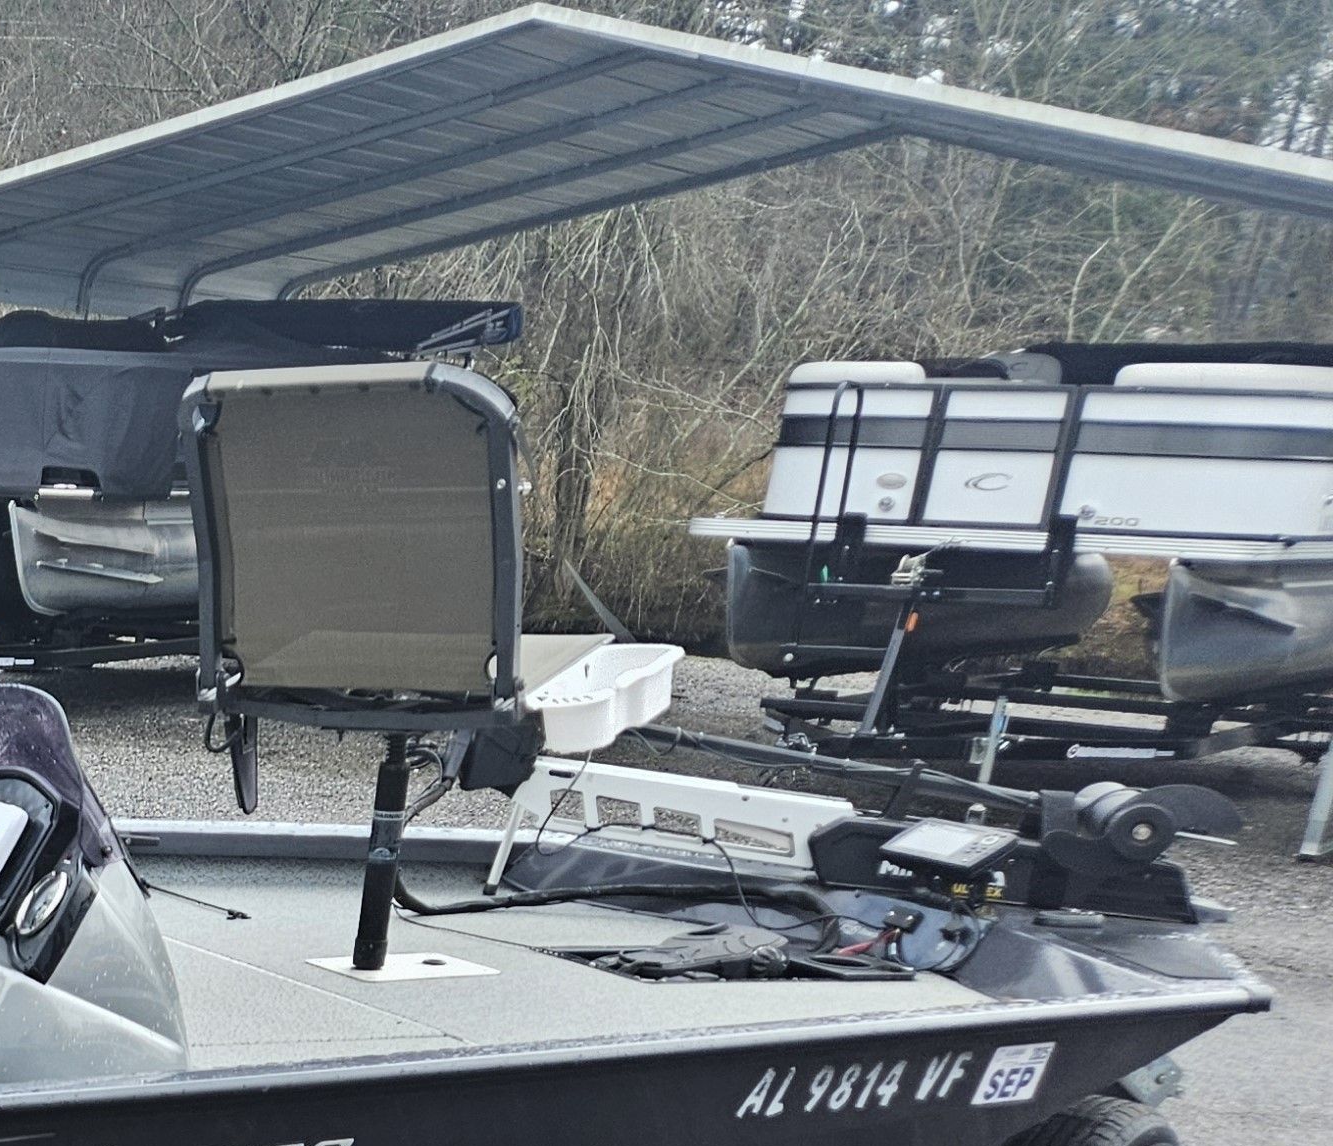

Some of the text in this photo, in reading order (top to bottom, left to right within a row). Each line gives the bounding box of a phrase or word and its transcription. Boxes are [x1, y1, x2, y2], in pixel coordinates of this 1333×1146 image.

[1093, 516, 1141, 527] 200
[735, 1051, 973, 1119] AL 9814 VF
[984, 1066, 1036, 1100] SEP
